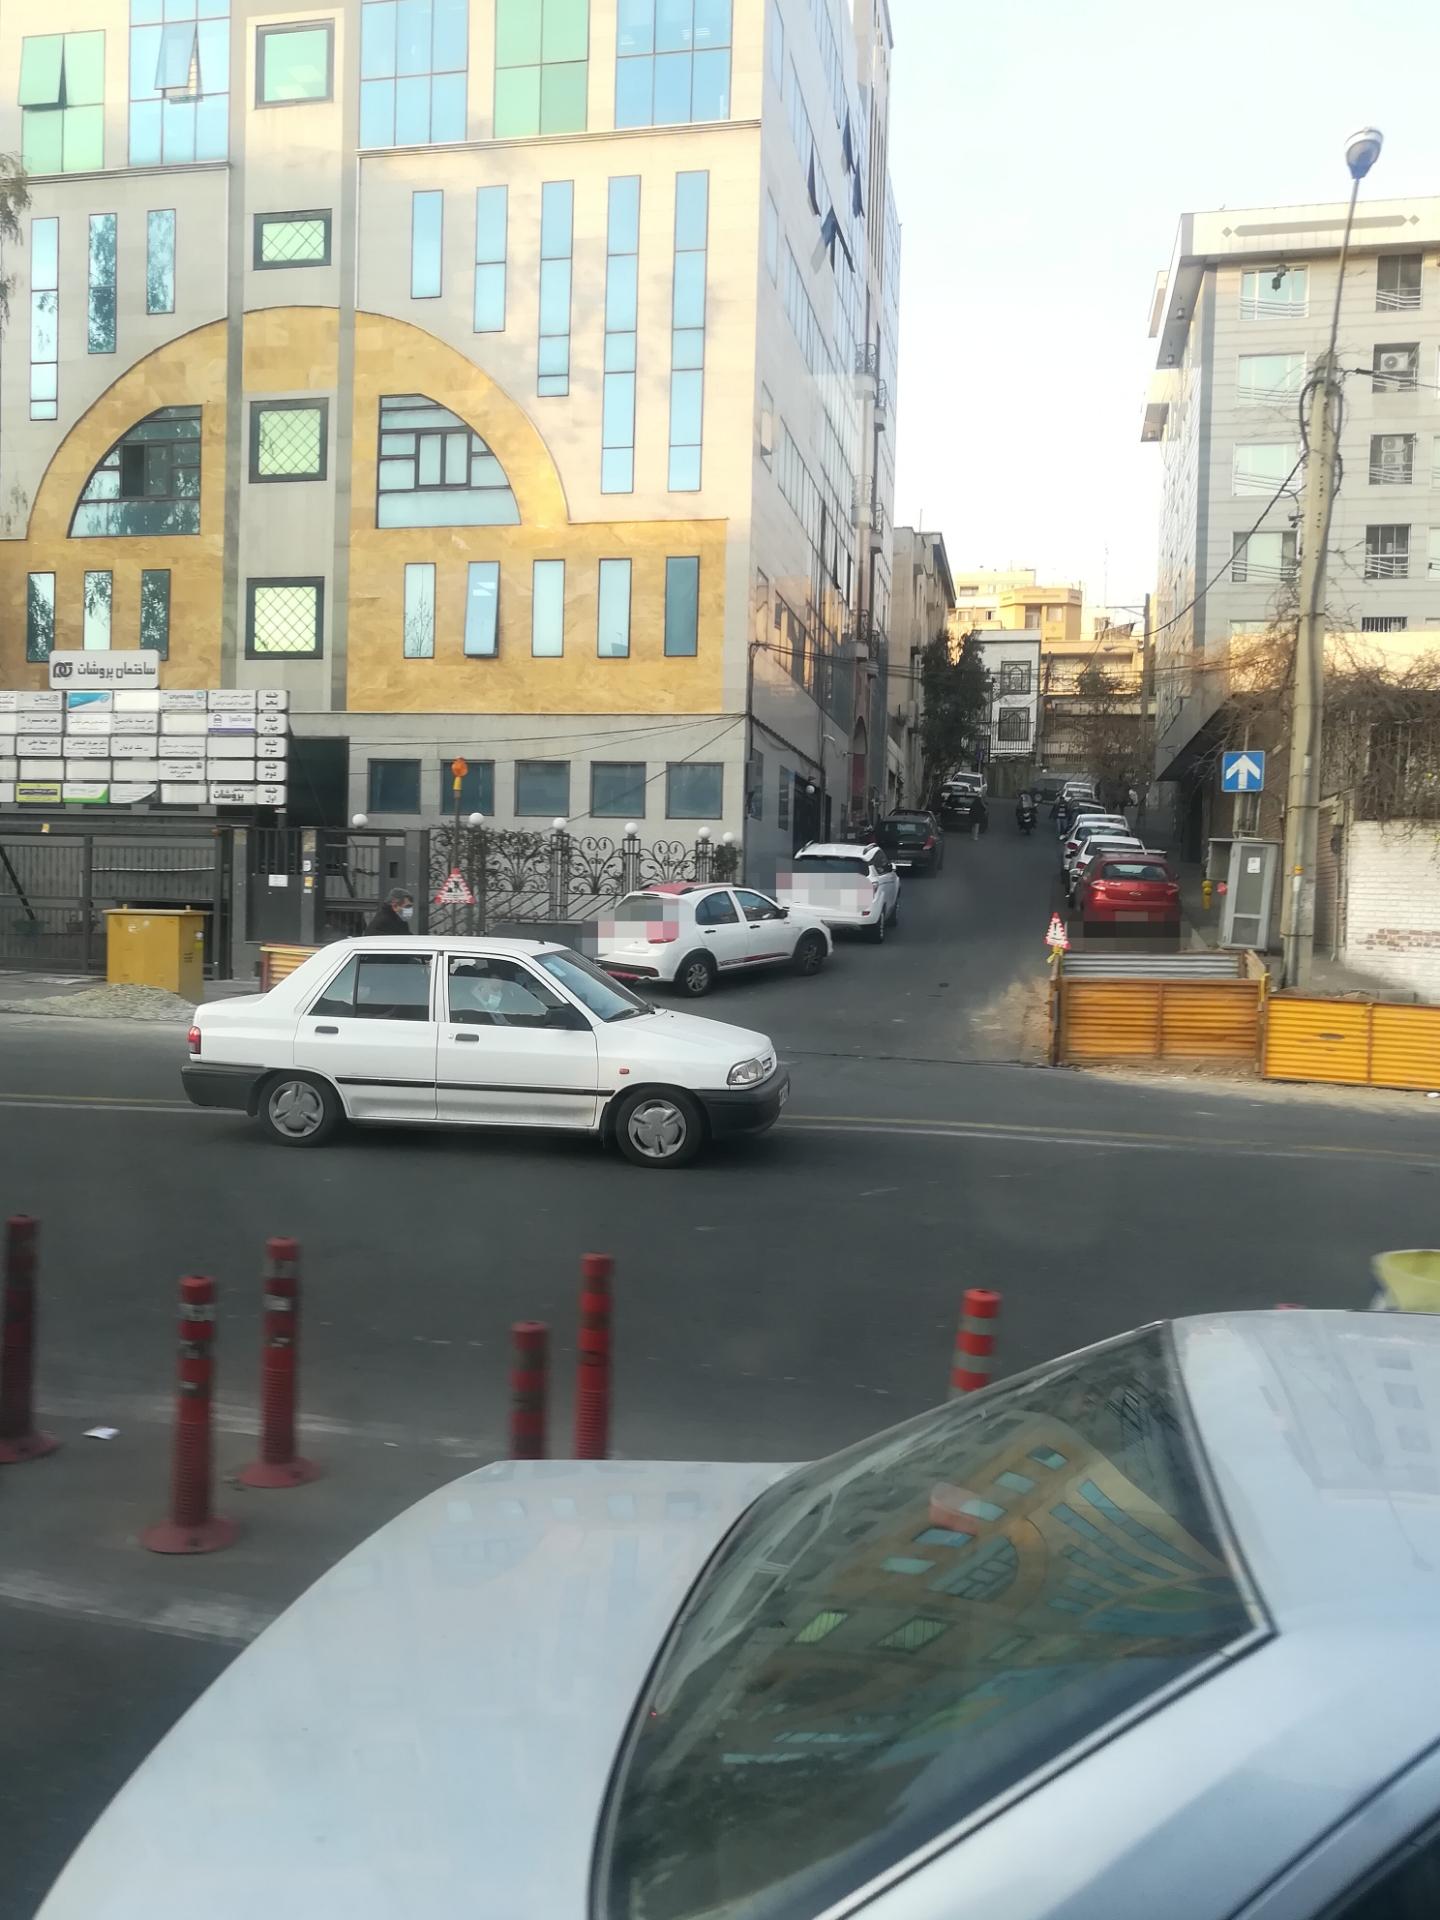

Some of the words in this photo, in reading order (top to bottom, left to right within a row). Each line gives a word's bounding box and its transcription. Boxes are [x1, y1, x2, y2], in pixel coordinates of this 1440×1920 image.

[78, 661, 114, 680] پروشات
[115, 661, 156, 679] ساختمان
[213, 789, 244, 802] پروشات
